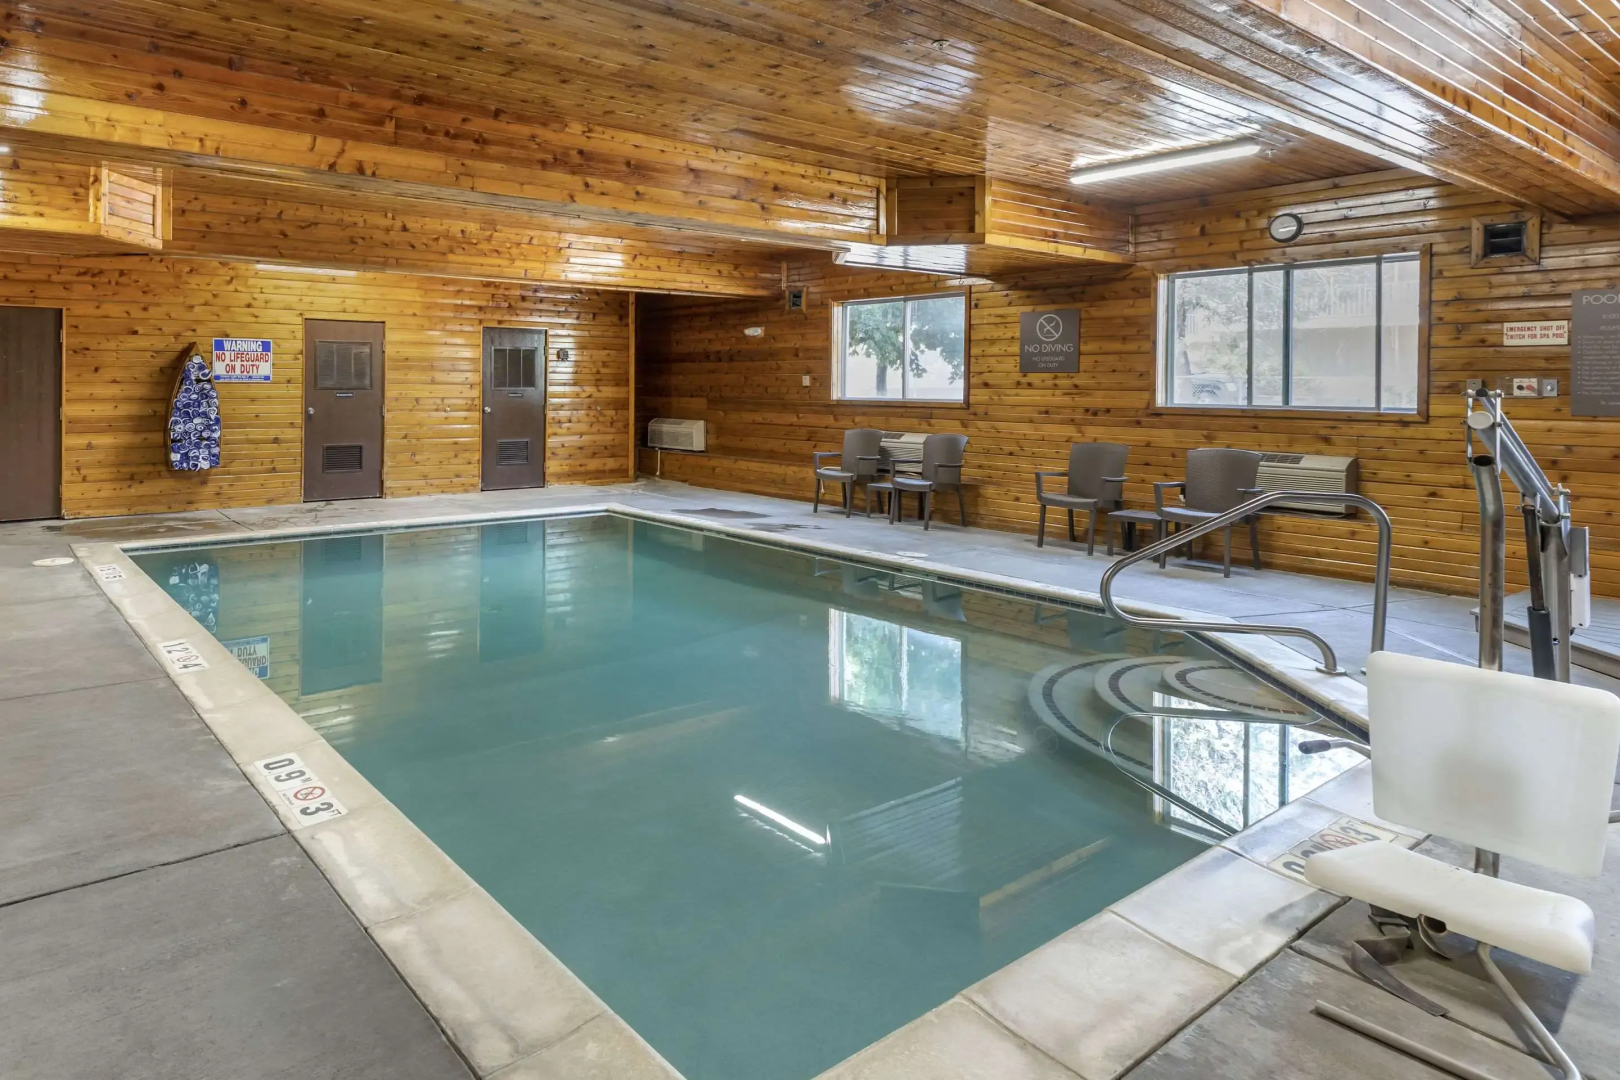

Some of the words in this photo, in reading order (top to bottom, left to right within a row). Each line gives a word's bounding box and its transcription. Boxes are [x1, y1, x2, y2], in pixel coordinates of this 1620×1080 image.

[223, 340, 263, 352] WARNING
[1024, 344, 1040, 353] NO
[1041, 343, 1074, 353] DIVING
[215, 352, 226, 362] NO
[229, 352, 270, 363] LIFEGUARD
[225, 364, 236, 374] ON
[240, 364, 260, 374] DUTY
[300, 801, 335, 816] 3
[327, 808, 342, 817] FT
[1339, 826, 1382, 842] 3
